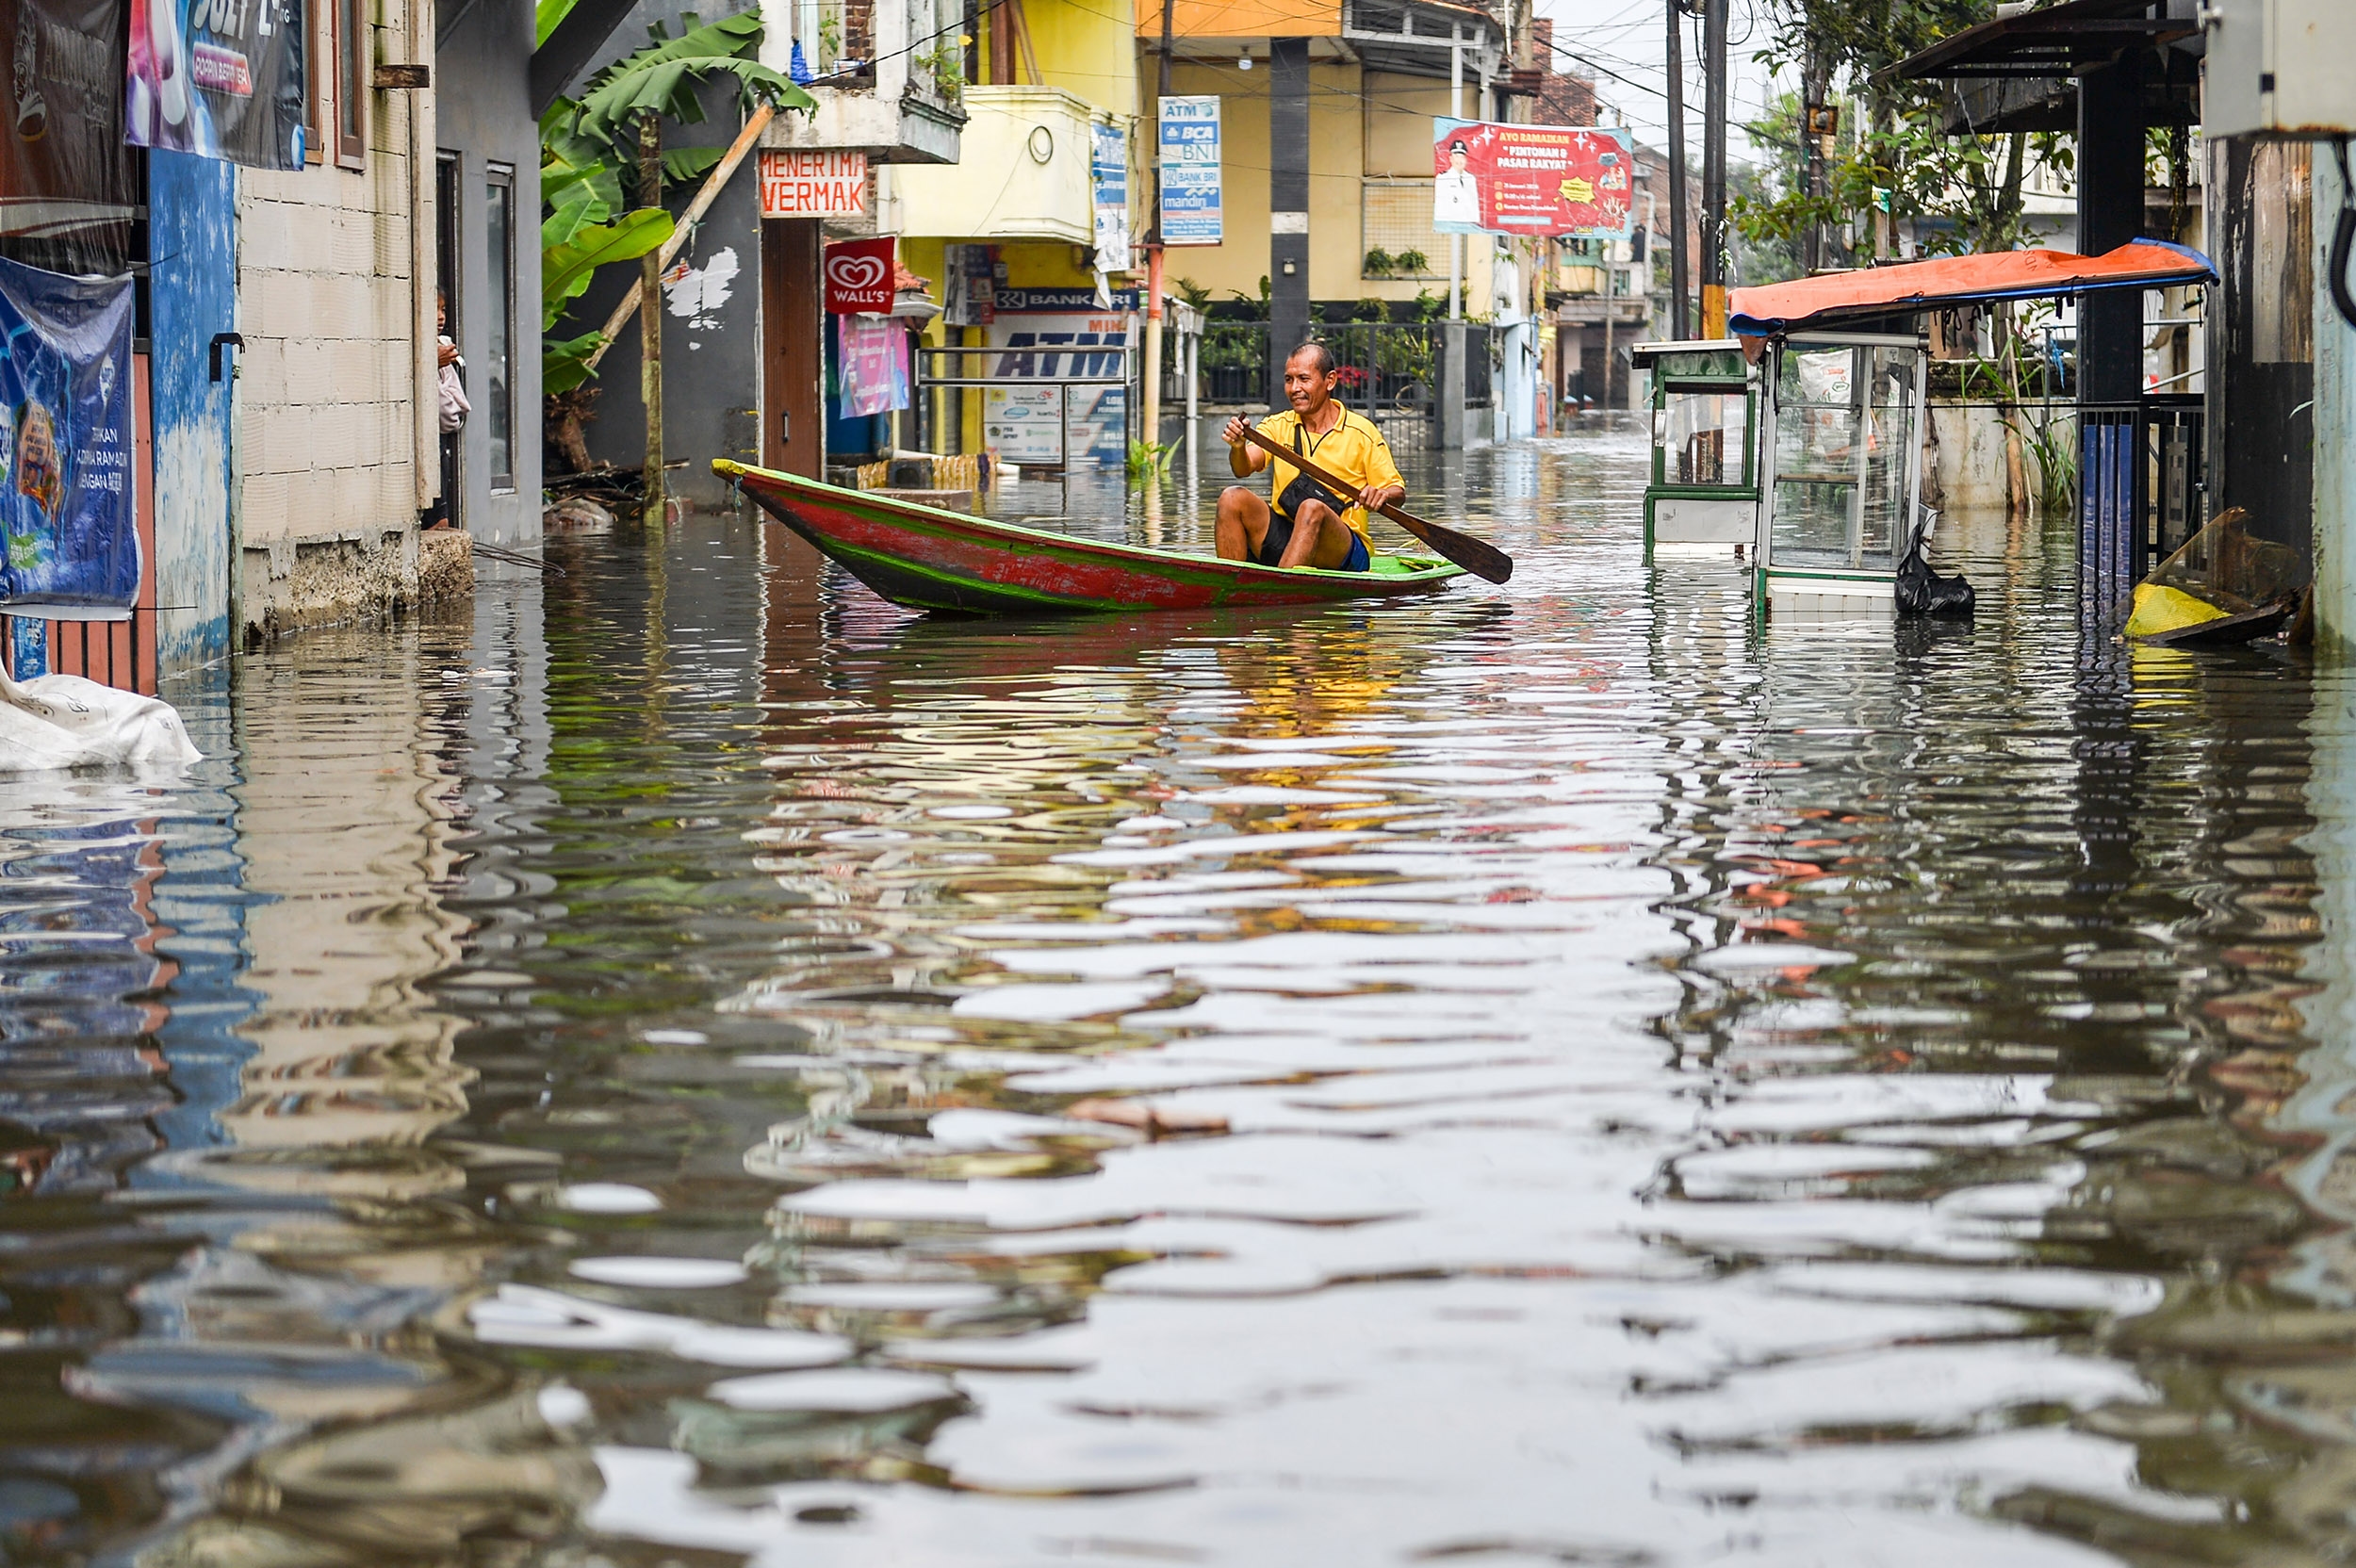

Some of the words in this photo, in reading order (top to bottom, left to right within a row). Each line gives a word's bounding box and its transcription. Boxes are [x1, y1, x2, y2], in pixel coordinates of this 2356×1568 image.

[1165, 105, 1196, 117] ATM
[1182, 126, 1214, 139] BCA
[1499, 133, 1519, 141] AYO
[1183, 144, 1217, 160] BNI
[1497, 157, 1530, 169] PASAR
[1530, 159, 1566, 171] RAKYAT
[1178, 172, 1202, 182] BANK
[1203, 172, 1217, 182] BRI
[761, 182, 865, 211] VERMAK
[833, 290, 885, 303] WALL'S
[1030, 295, 1091, 304] BANK
[1110, 294, 1131, 304] RI
[1088, 319, 1127, 333] MIN
[995, 333, 1127, 377] ATM
